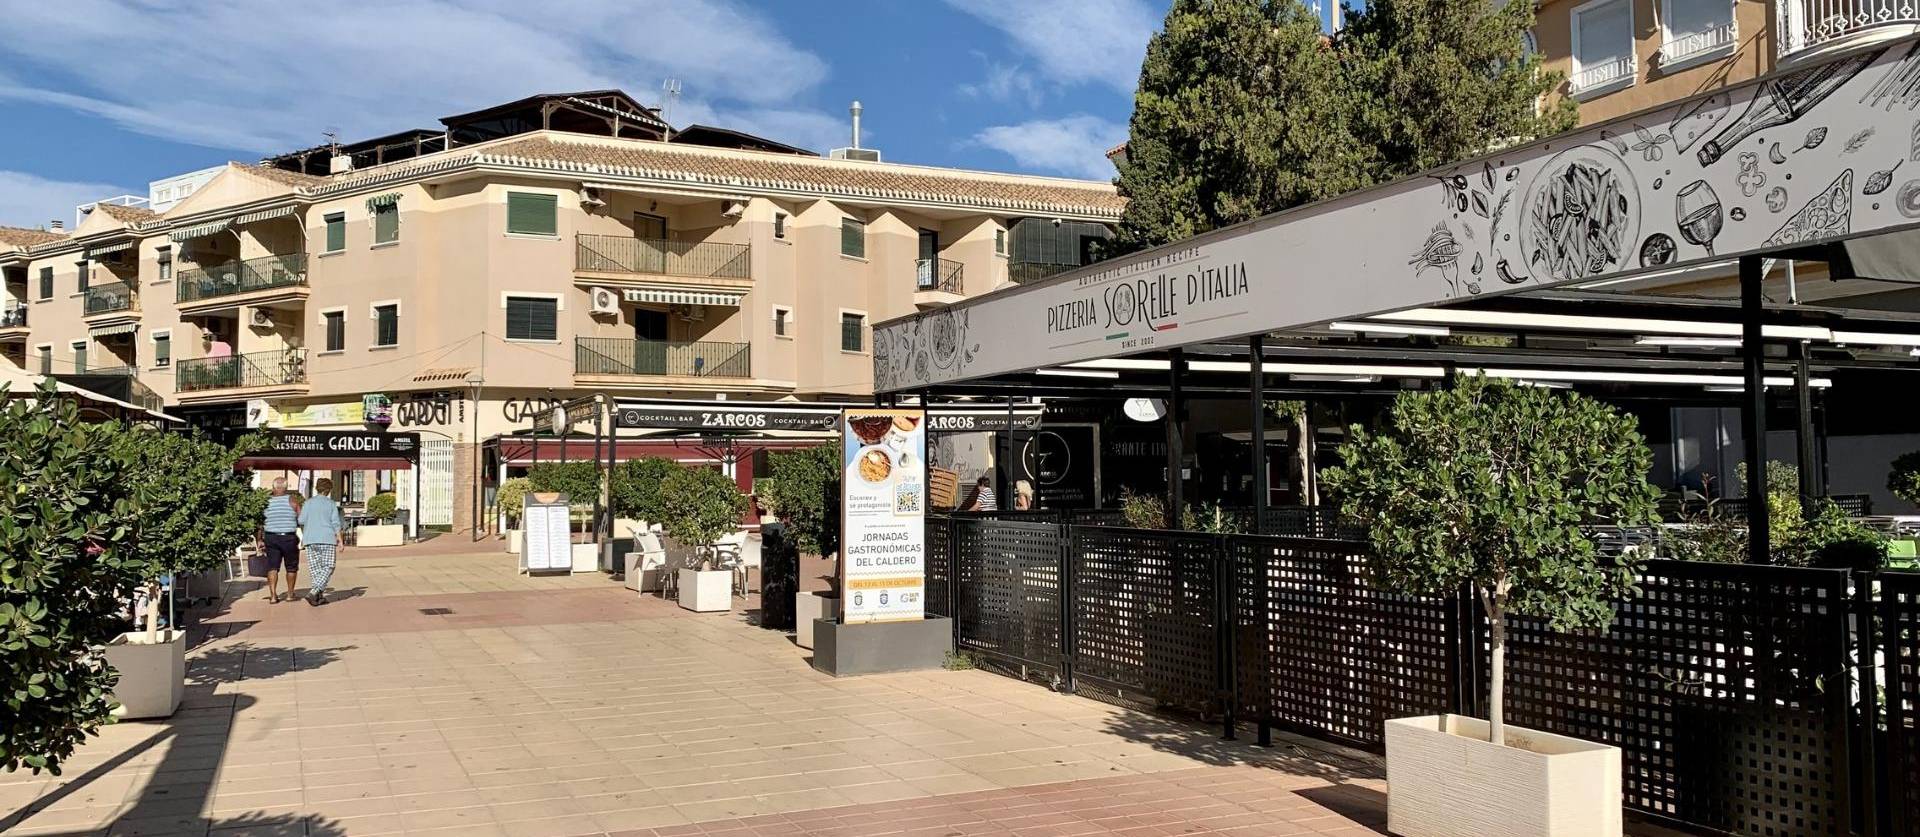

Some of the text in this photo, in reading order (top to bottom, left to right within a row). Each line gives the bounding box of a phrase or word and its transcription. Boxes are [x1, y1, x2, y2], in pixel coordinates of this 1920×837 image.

[1078, 247, 1200, 286] AUTHENTIC ITALIAN RECIPE
[1048, 261, 1249, 334] PIZZERIA SORELLE D'ITALIA
[1121, 339, 1137, 349] SINCE
[701, 413, 766, 427] ZARCOS
[927, 416, 975, 429] ARCOS
[284, 435, 316, 443] PIZZERIA
[328, 436, 380, 451] GARDEN
[862, 532, 909, 542] JORNADAS
[847, 543, 922, 555] GASTRONÓMICAS
[856, 556, 916, 567] DEL CALDERO
